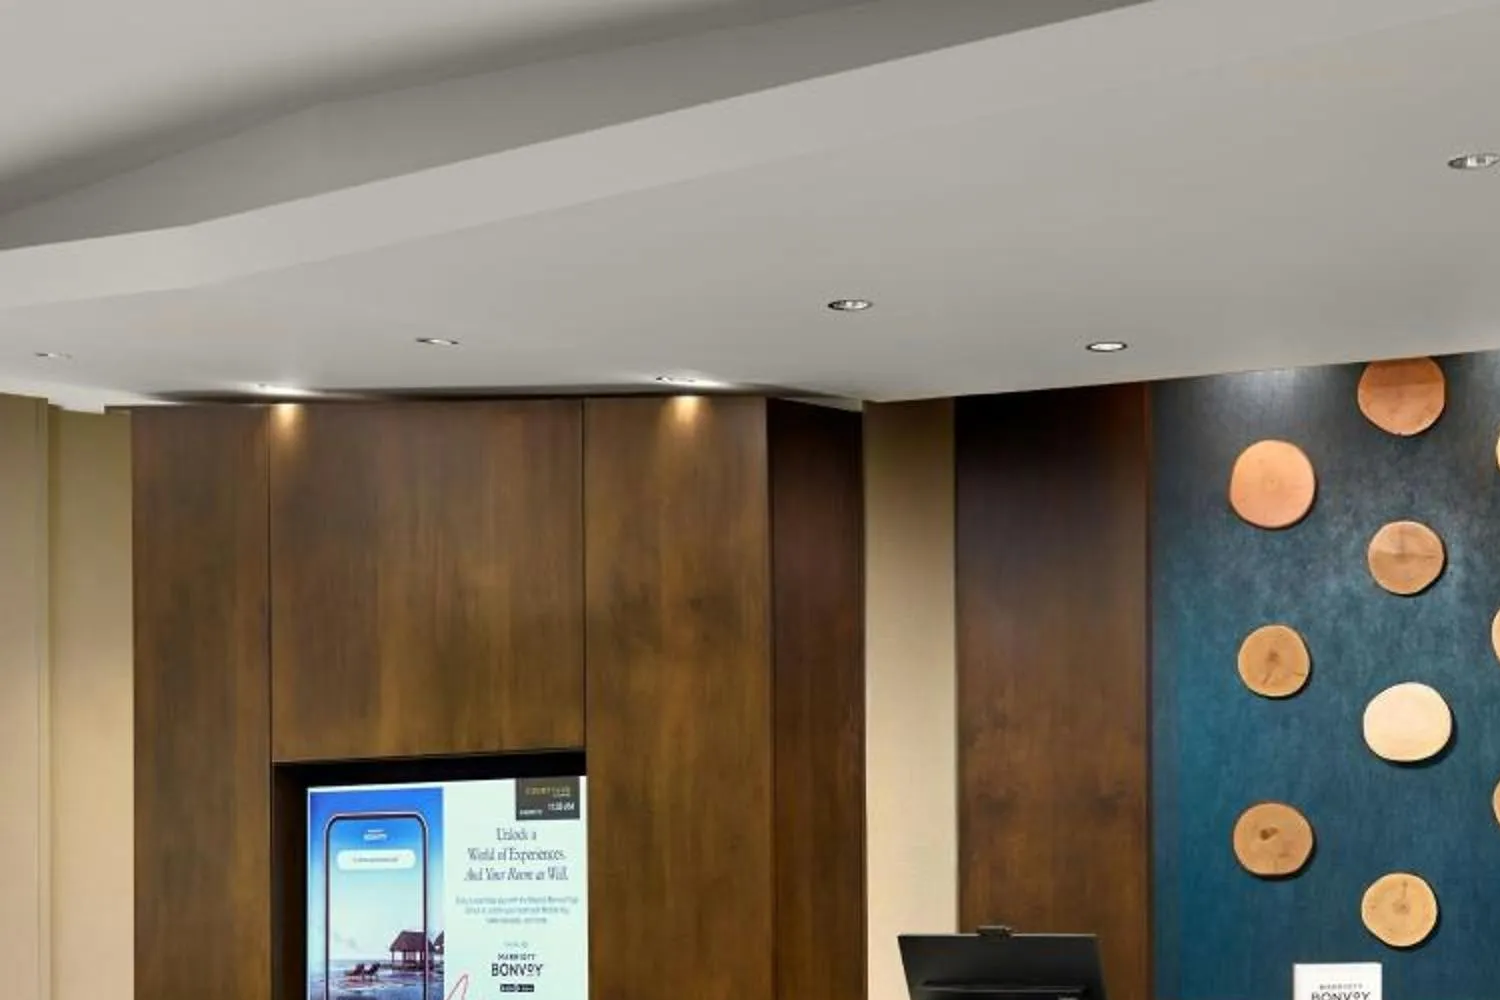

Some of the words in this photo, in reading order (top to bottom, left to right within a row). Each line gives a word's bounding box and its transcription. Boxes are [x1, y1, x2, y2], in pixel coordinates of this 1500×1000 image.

[496, 828, 528, 841] Unlock
[468, 848, 495, 860] World
[491, 963, 544, 976] BONVOY
